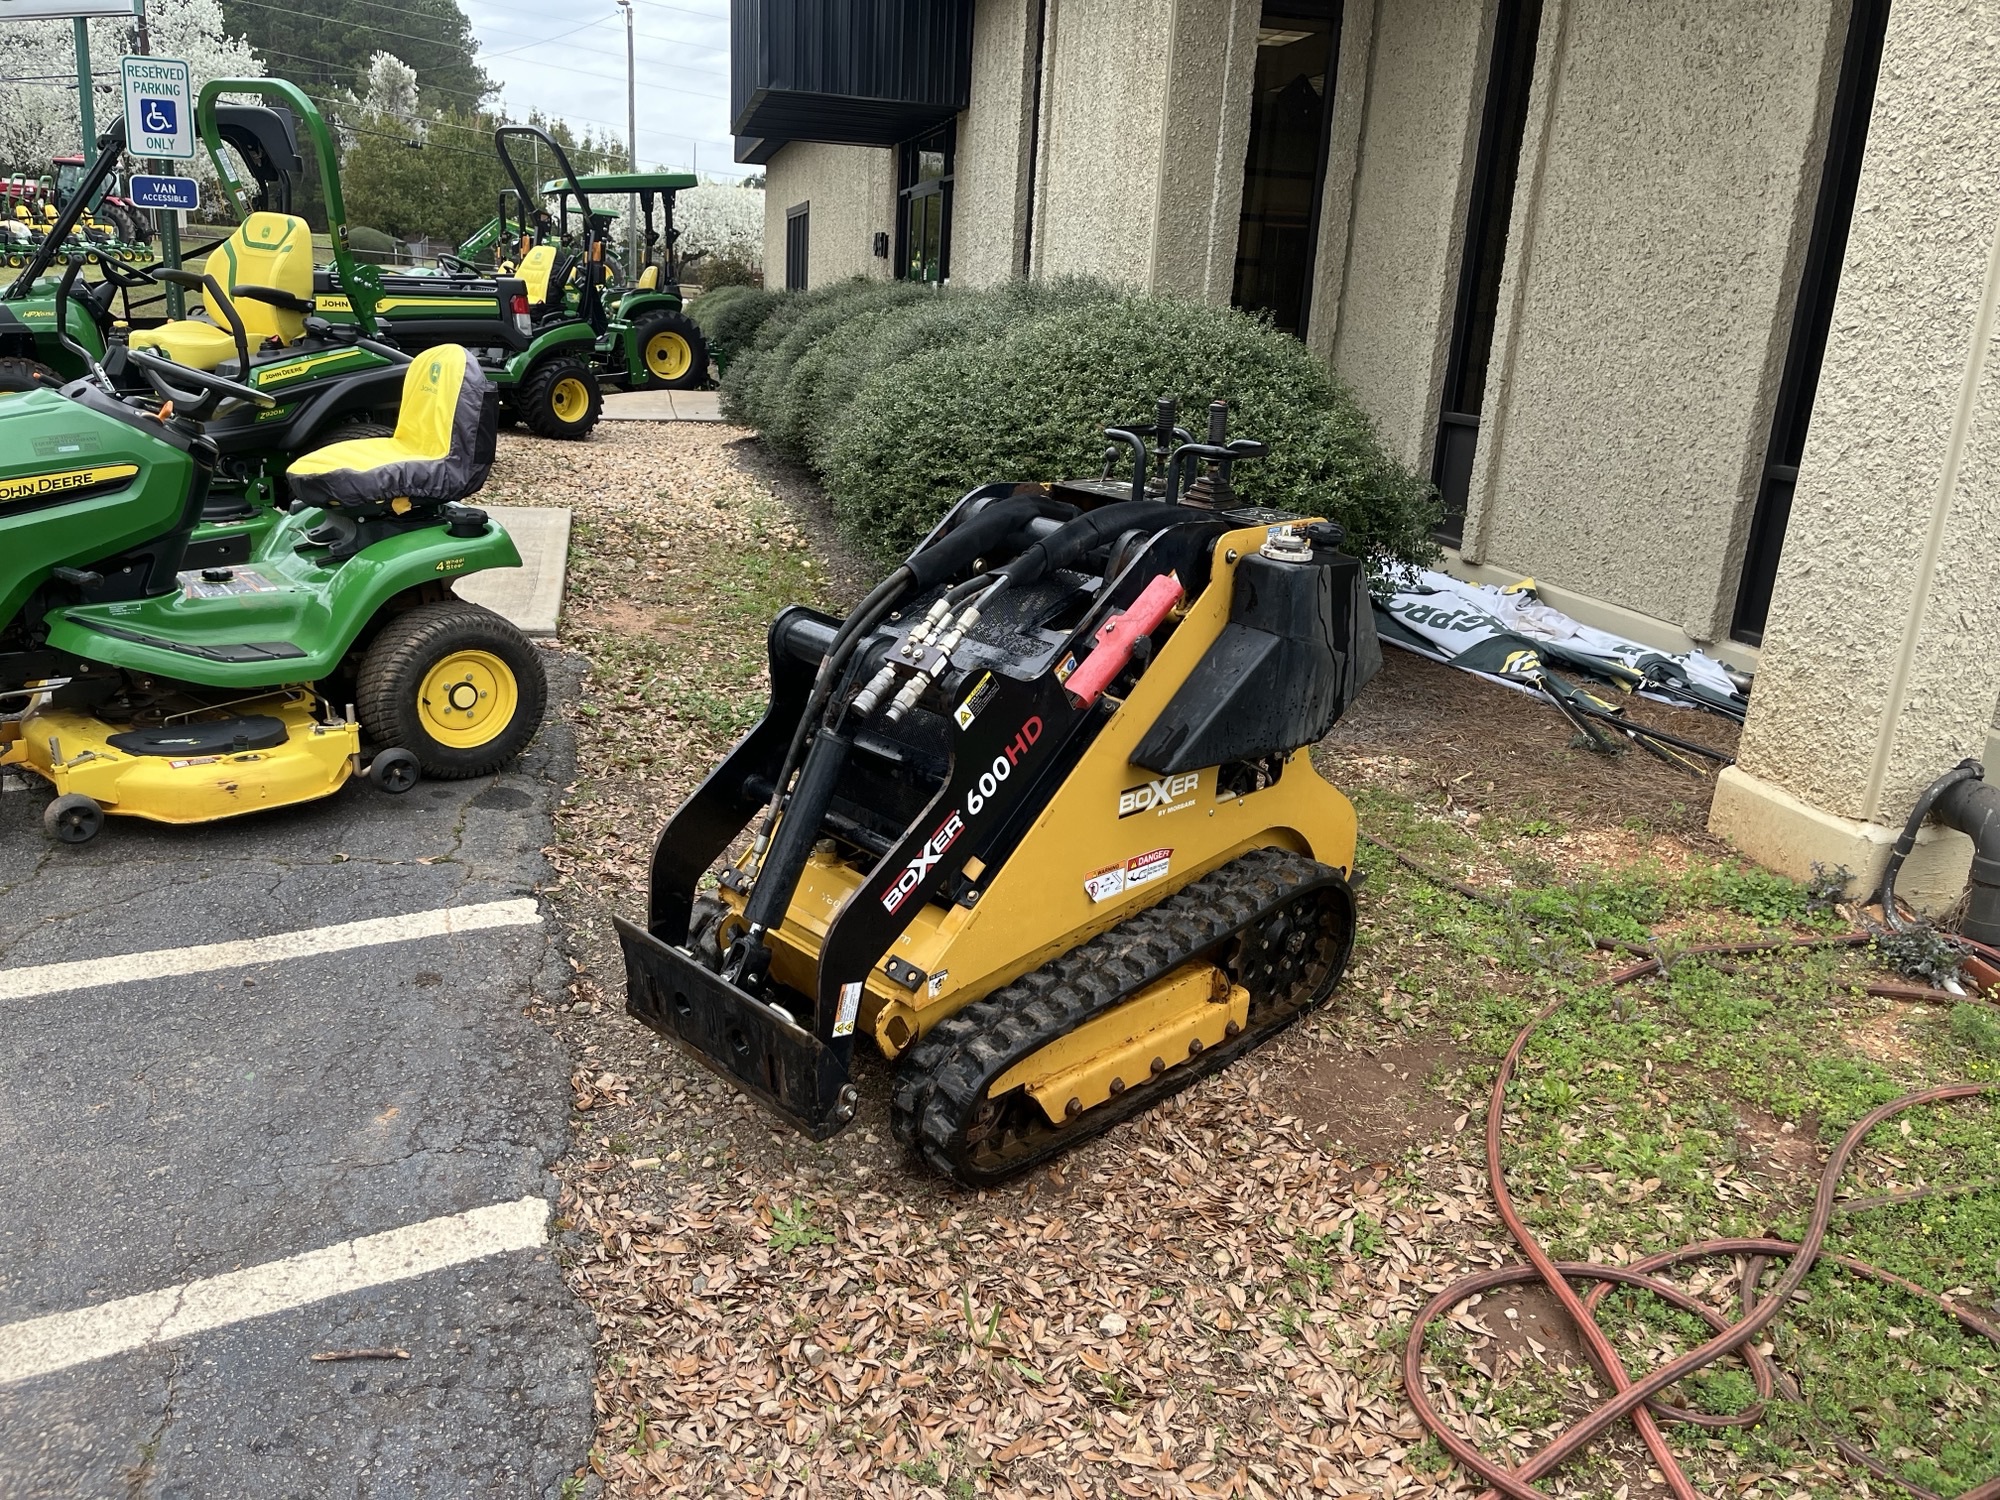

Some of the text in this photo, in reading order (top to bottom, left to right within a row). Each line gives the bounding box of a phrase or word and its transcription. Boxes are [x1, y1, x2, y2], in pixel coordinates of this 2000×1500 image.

[127, 65, 184, 80] RESERVED
[133, 81, 180, 96] PARKING
[146, 137, 175, 150] ONLY
[153, 183, 176, 194] VAN
[142, 193, 188, 203] ACCESSIBLE
[322, 300, 348, 308] JOHN
[265, 366, 303, 380] JOHN DEERE
[260, 409, 285, 419] Z920M
[0, 472, 93, 499] OHN DEERE
[436, 561, 444, 571] 4
[1119, 773, 1199, 812] BOXER
[1158, 808, 1167, 817] BY
[882, 814, 964, 913] BOXER
[1138, 849, 1170, 866] DANGER
